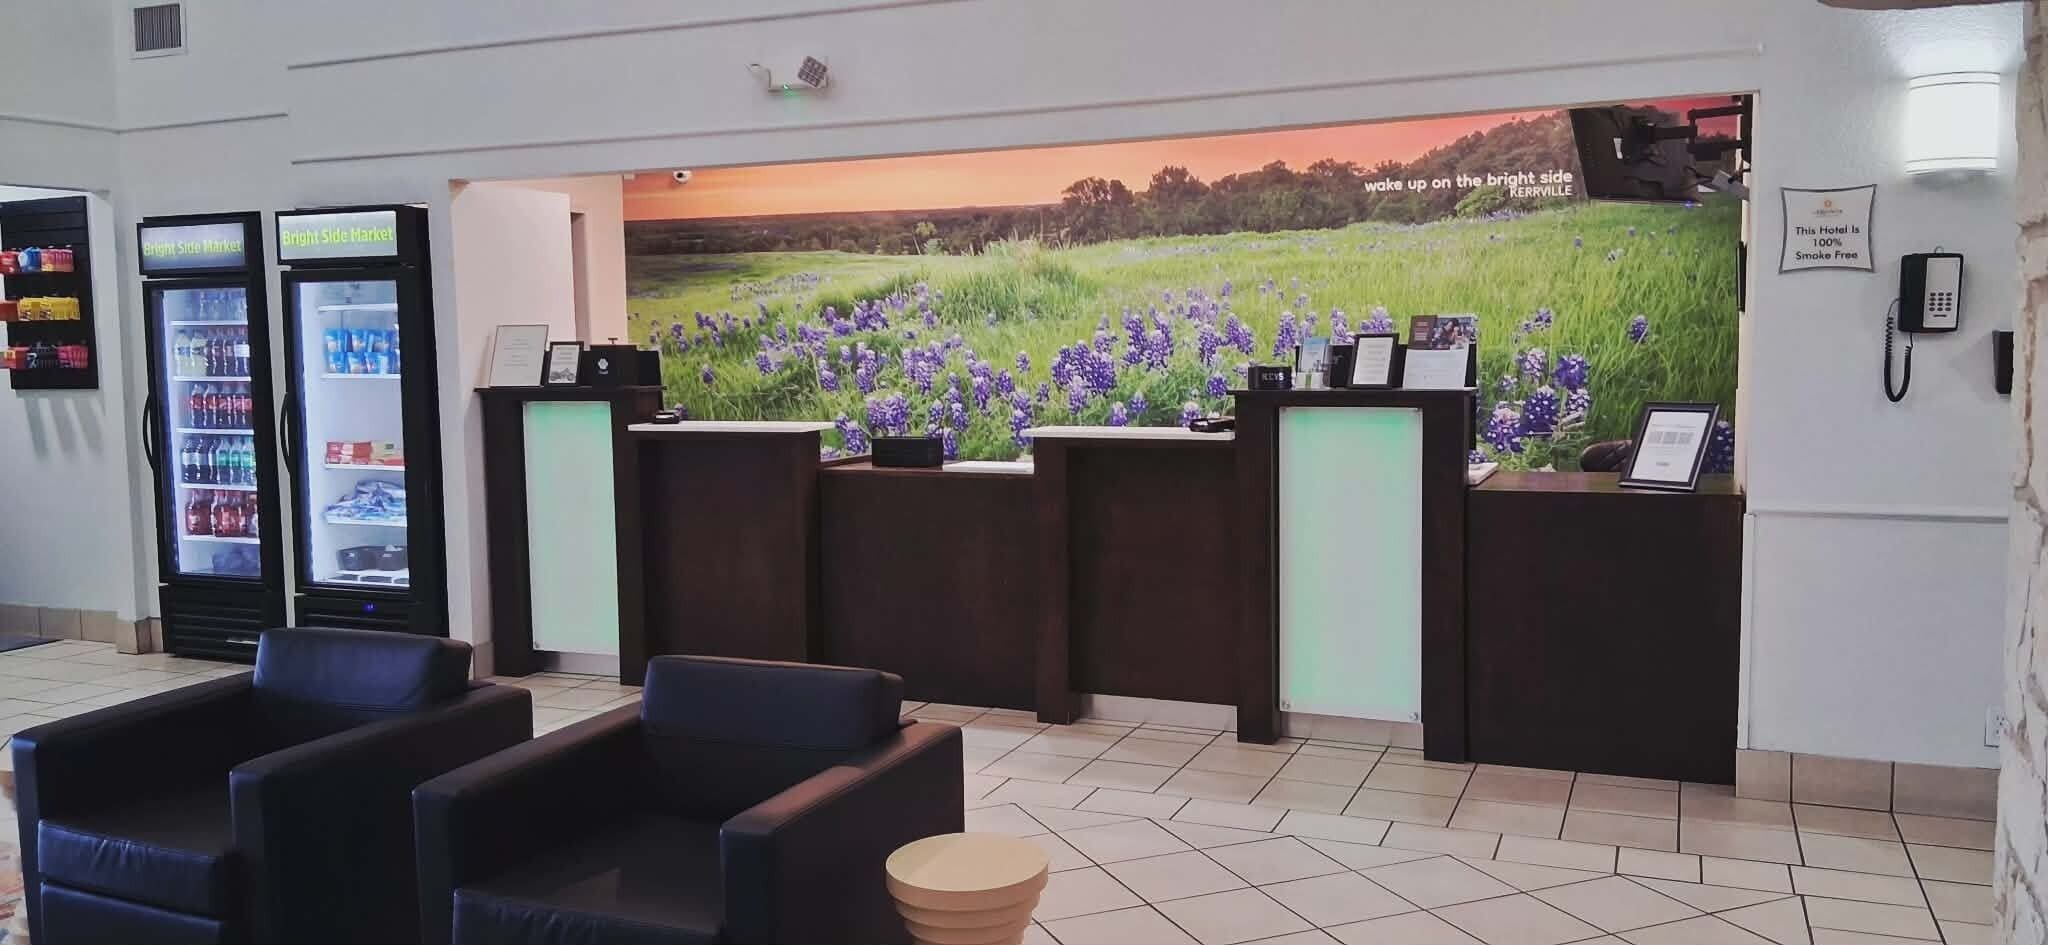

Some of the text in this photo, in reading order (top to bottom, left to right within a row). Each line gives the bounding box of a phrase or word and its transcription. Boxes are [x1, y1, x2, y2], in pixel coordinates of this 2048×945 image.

[1364, 169, 1573, 193] wake up on the bright side
[1510, 185, 1572, 198] KERRVILLE
[283, 225, 393, 247] Bright Side Market
[1795, 224, 1860, 236] This Hotel Is
[144, 239, 241, 256] Bright Side Market
[1813, 238, 1843, 248] 100%
[1795, 250, 1858, 260] Smoke Free
